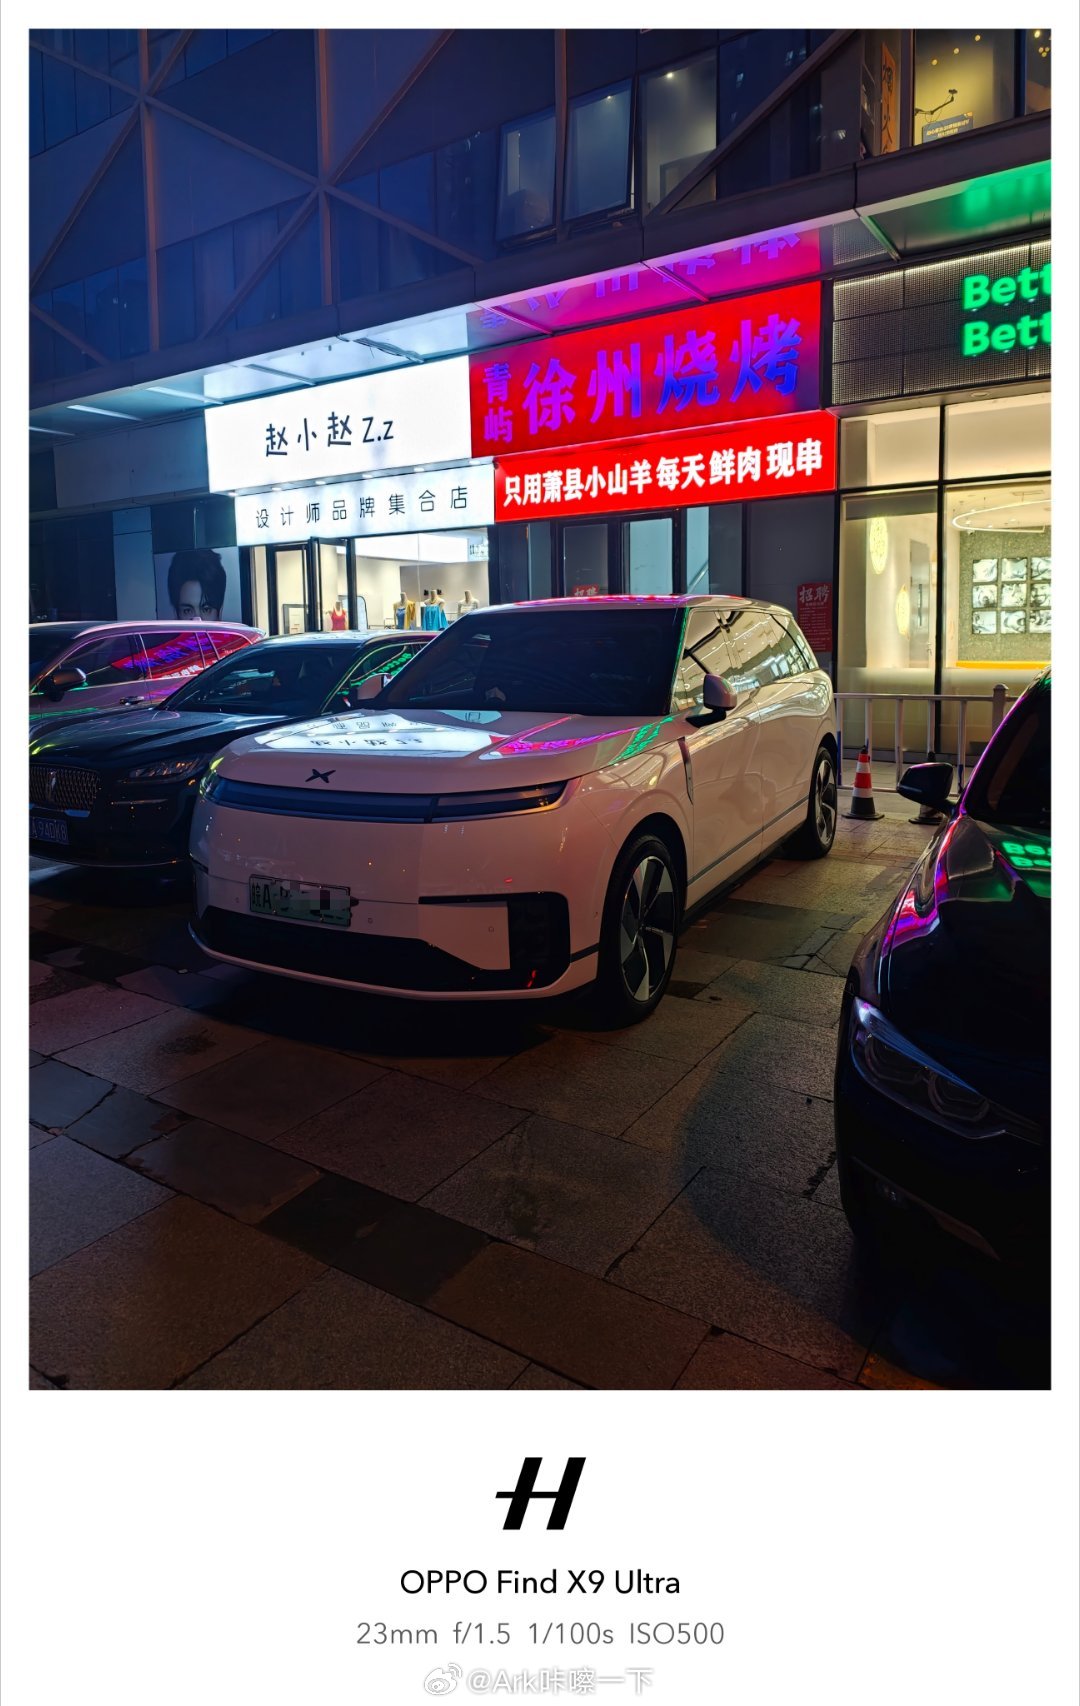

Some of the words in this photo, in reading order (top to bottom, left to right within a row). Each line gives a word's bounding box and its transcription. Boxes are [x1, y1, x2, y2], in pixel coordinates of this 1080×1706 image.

[522, 313, 803, 435] 徐州烧烤
[265, 411, 353, 457] 赵小赵
[255, 486, 469, 529] 设计师品牌集合店
[799, 584, 830, 603] 招聘
